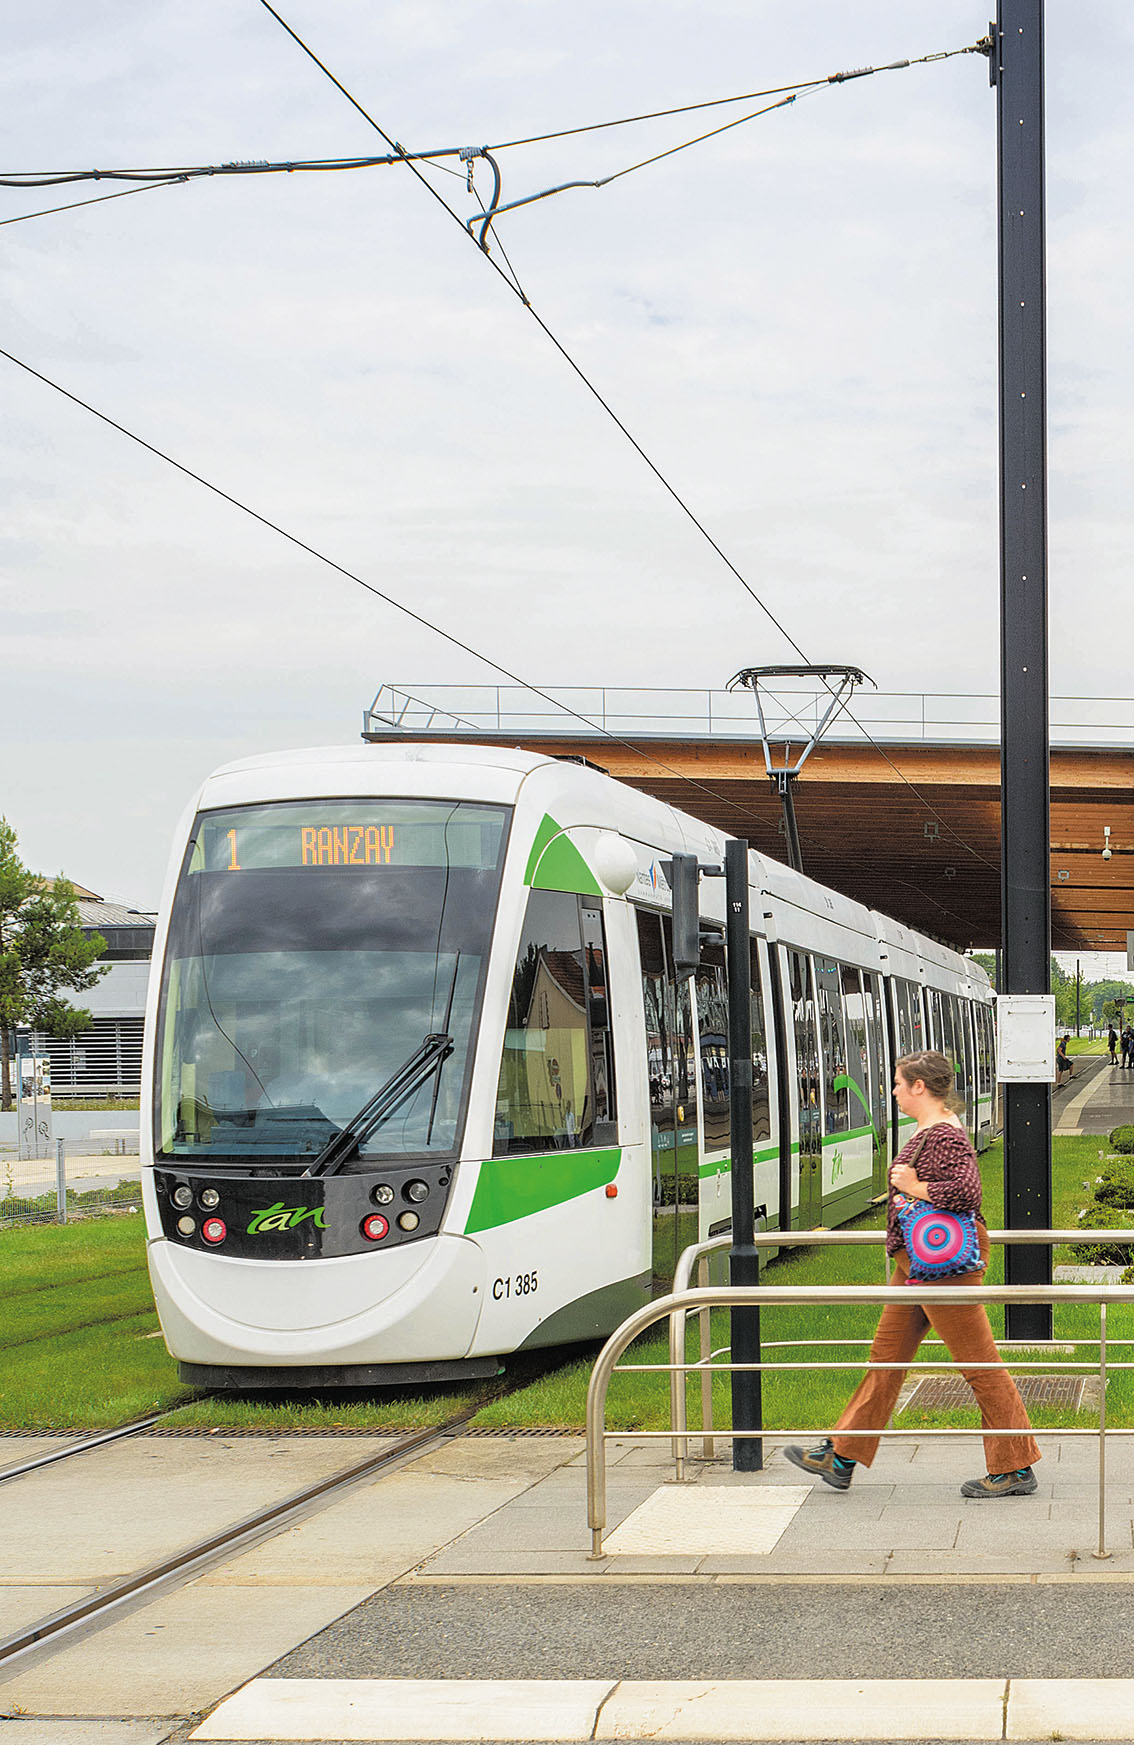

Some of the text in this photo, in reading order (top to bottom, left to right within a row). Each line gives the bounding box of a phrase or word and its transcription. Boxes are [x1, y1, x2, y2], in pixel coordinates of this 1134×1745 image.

[226, 826, 394, 870] 1 RANZAY
[246, 1202, 332, 1235] tan
[492, 1270, 538, 1301] C1 385
